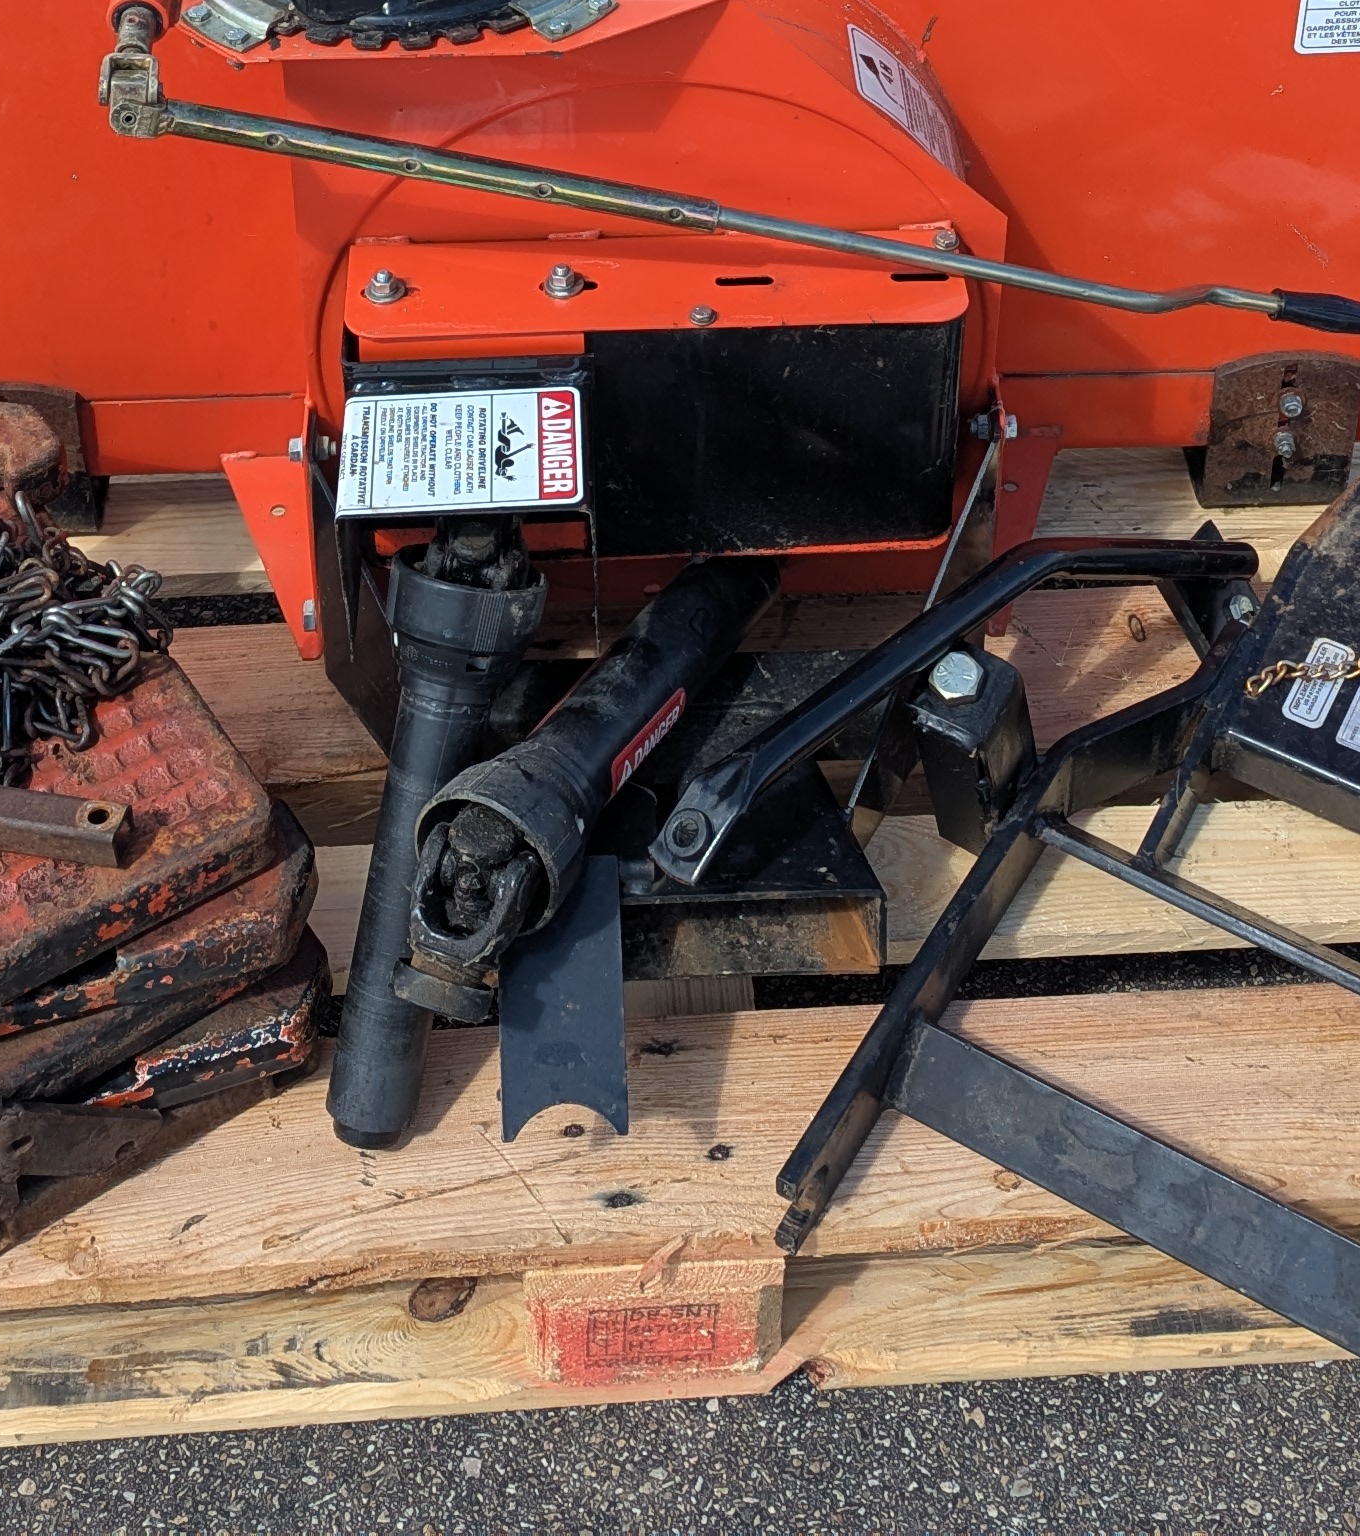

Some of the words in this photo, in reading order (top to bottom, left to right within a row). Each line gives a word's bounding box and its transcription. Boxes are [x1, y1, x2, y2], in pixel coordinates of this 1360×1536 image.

[430, 403, 437, 412] DO
[360, 406, 370, 463] TRANSMISSION
[445, 429, 453, 447] WELL
[454, 422, 462, 447] PEOPLE
[478, 408, 486, 445] ROTATING
[349, 442, 359, 476] CARDAN
[429, 430, 437, 462] OPERATE
[466, 449, 474, 471] CAUSE
[541, 418, 574, 494] DANGER
[428, 464, 436, 497] WITHOUT
[453, 463, 461, 495] CLOTHING
[478, 448, 486, 489] DRIVELINE
[357, 466, 367, 506] ROTATIVE
[634, 705, 680, 768] DANGER
